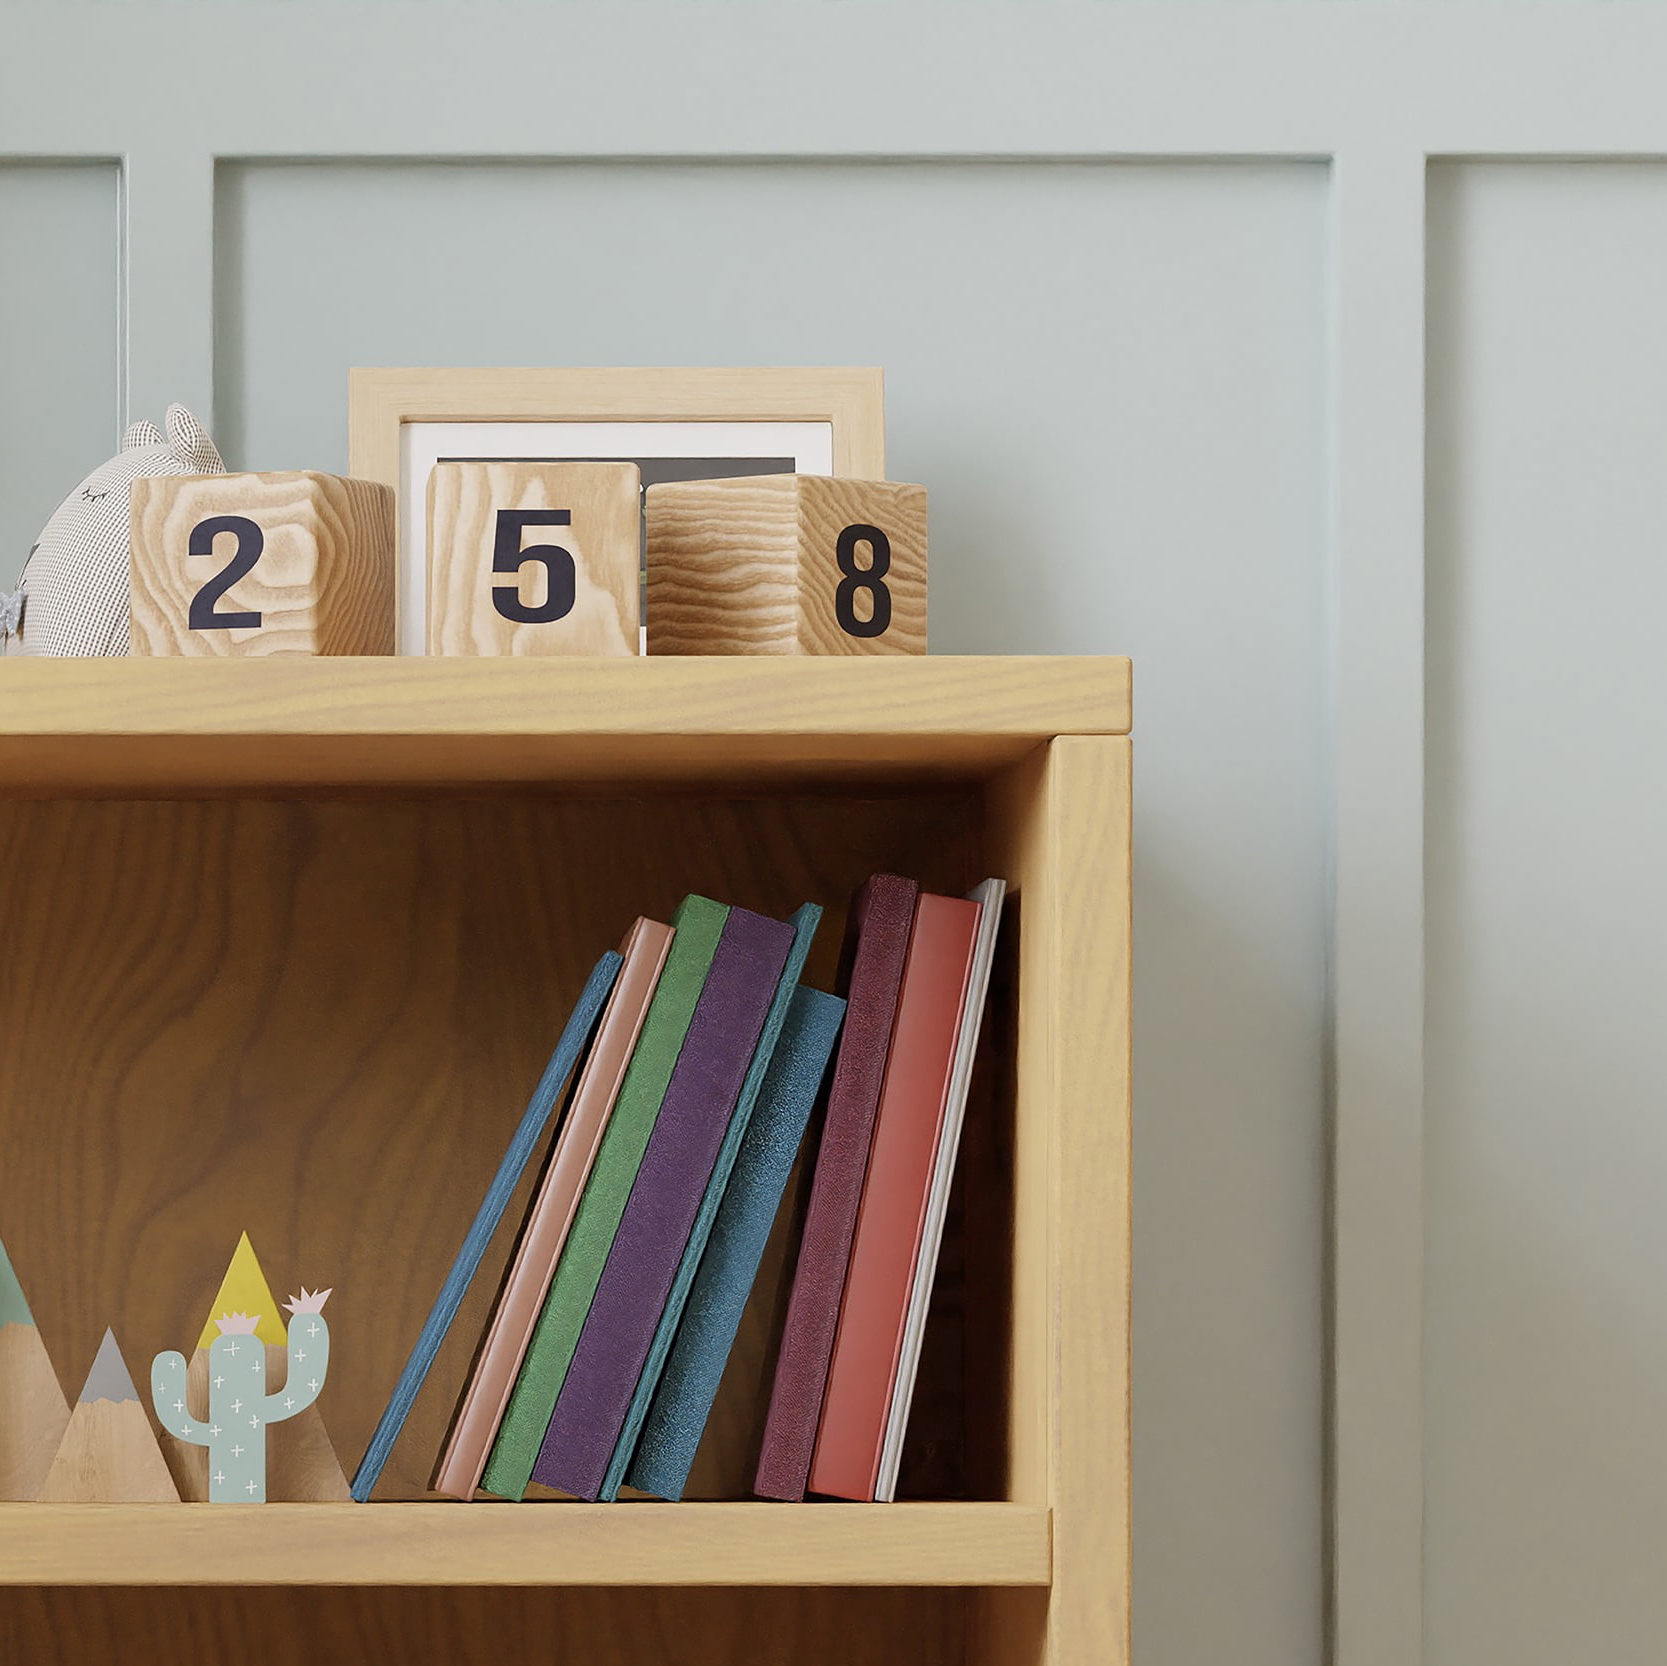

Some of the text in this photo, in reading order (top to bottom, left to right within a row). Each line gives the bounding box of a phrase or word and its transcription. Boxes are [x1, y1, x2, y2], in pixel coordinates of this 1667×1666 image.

[187, 514, 265, 631] 2
[490, 508, 577, 625] 5
[834, 522, 893, 639] 8
